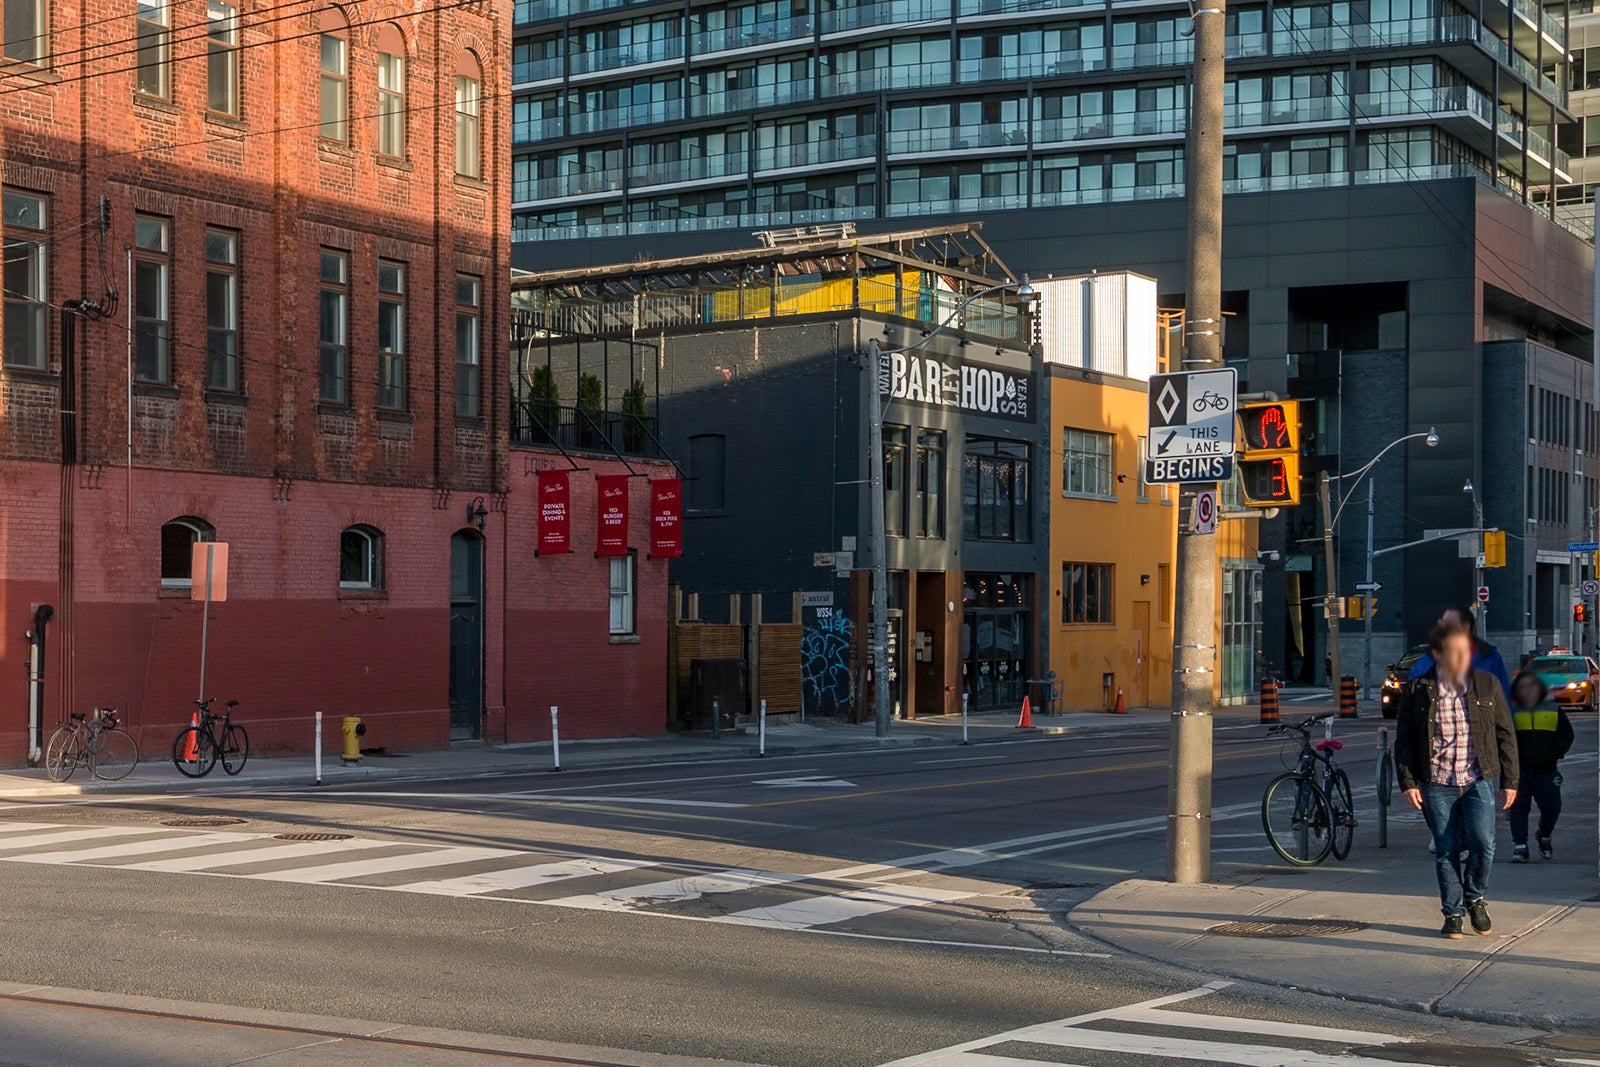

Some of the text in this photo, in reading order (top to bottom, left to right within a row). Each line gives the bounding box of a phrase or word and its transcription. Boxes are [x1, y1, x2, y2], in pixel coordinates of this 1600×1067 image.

[1017, 378, 1028, 418] YEAST
[1190, 427, 1218, 439] THIS
[1186, 441, 1221, 454] LANE
[1153, 457, 1224, 480] BEGINS
[1272, 459, 1286, 496] 3
[807, 594, 830, 603] astral
